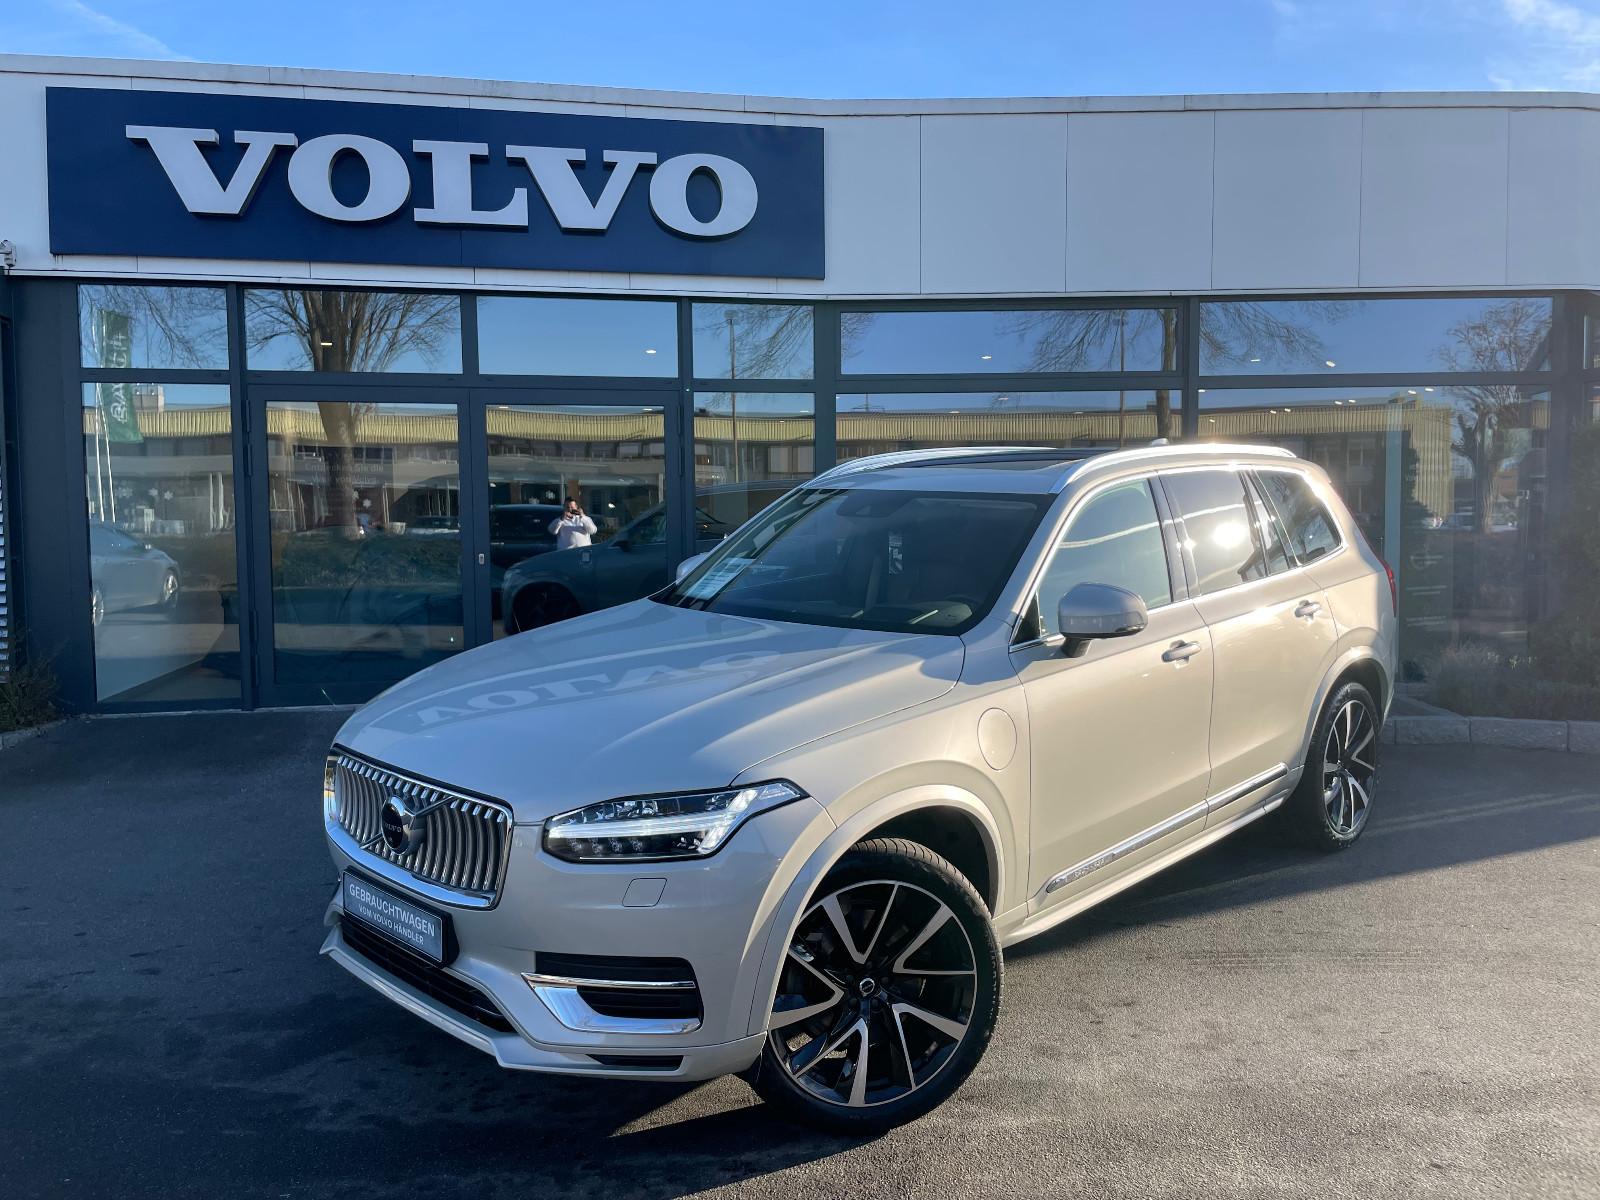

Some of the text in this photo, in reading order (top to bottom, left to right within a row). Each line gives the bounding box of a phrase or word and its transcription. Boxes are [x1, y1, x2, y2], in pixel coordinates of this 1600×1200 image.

[125, 124, 759, 237] VOLVO
[349, 883, 435, 937] GEBRAUCHTWAGEN
[359, 903, 425, 945] VOM VOLVO HÄNDLER
